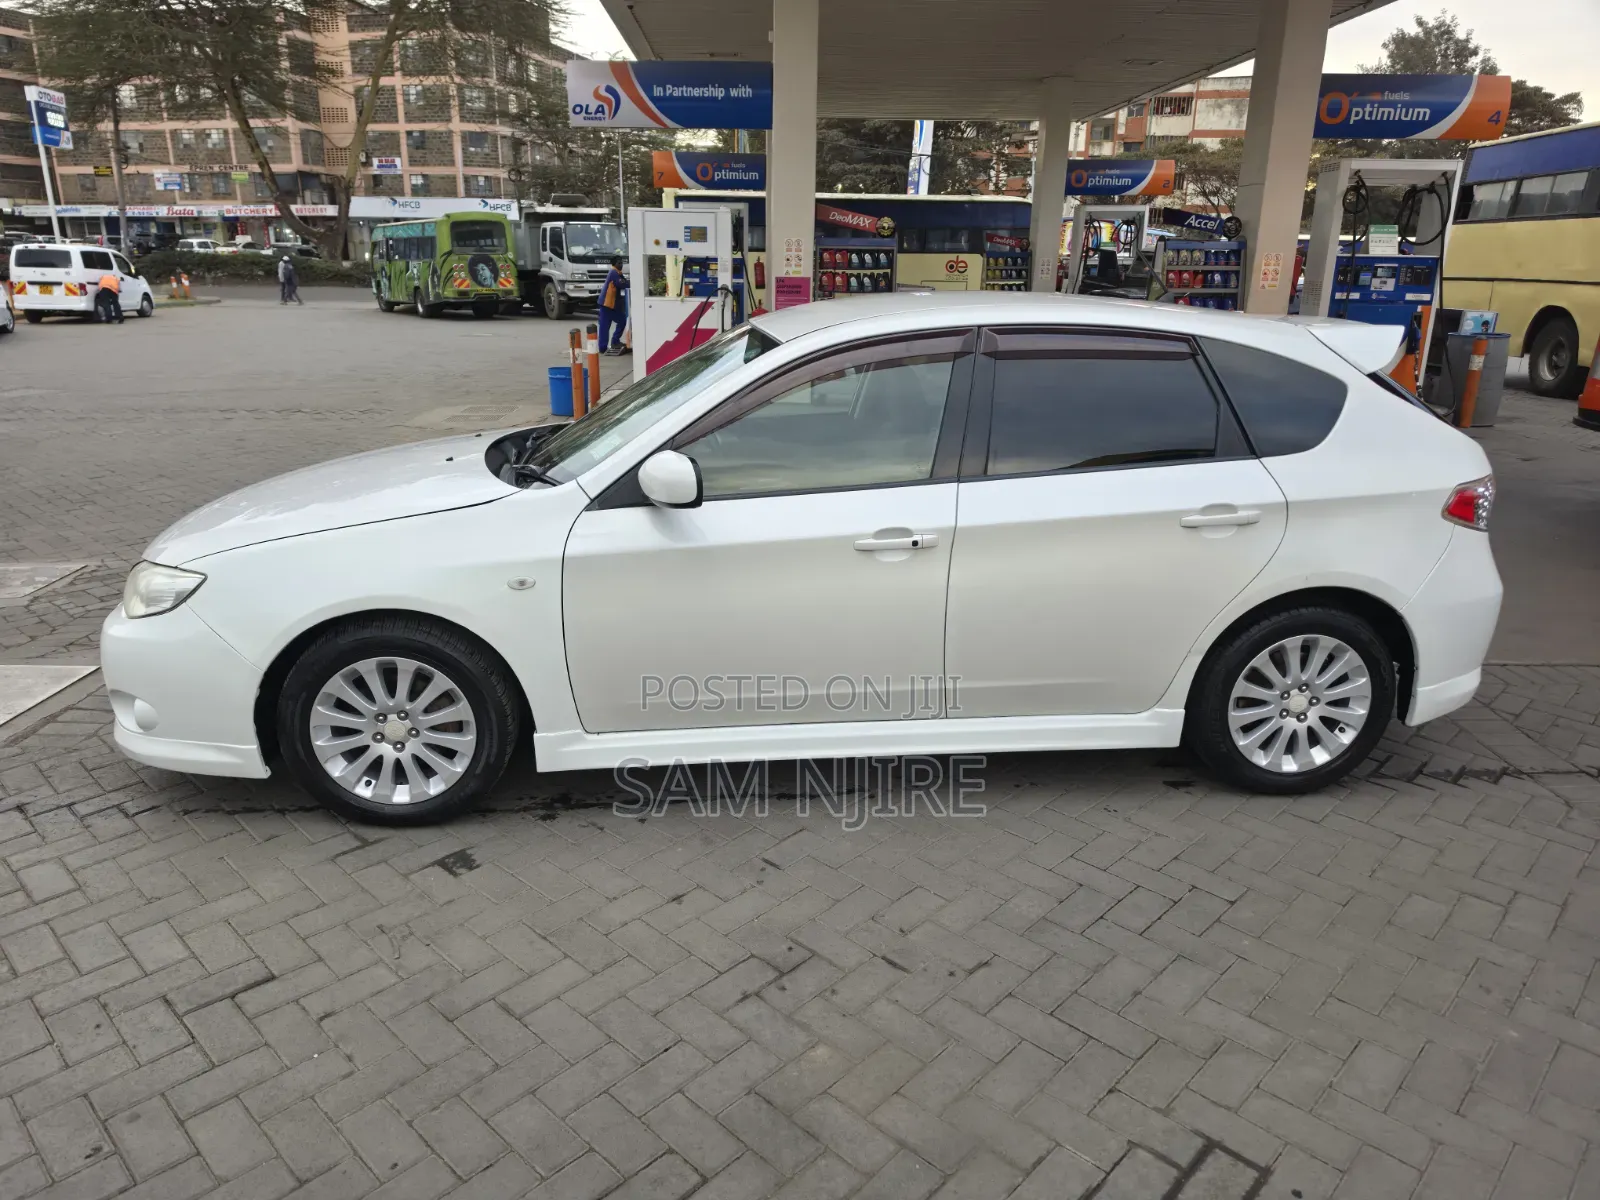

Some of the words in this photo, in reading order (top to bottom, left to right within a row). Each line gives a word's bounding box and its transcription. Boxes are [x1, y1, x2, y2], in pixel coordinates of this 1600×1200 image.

[653, 85, 663, 97] In
[666, 84, 725, 99] Partnership
[730, 85, 752, 98] with
[1384, 90, 1410, 100] fuels
[572, 104, 606, 116] OLA
[1487, 110, 1502, 126] 4
[657, 172, 664, 181] 7
[398, 201, 421, 209] HFCB
[489, 203, 512, 212] HFCB
[166, 206, 195, 216] Bata
[829, 211, 873, 228] DeoMAX
[1184, 215, 1220, 230] Accel
